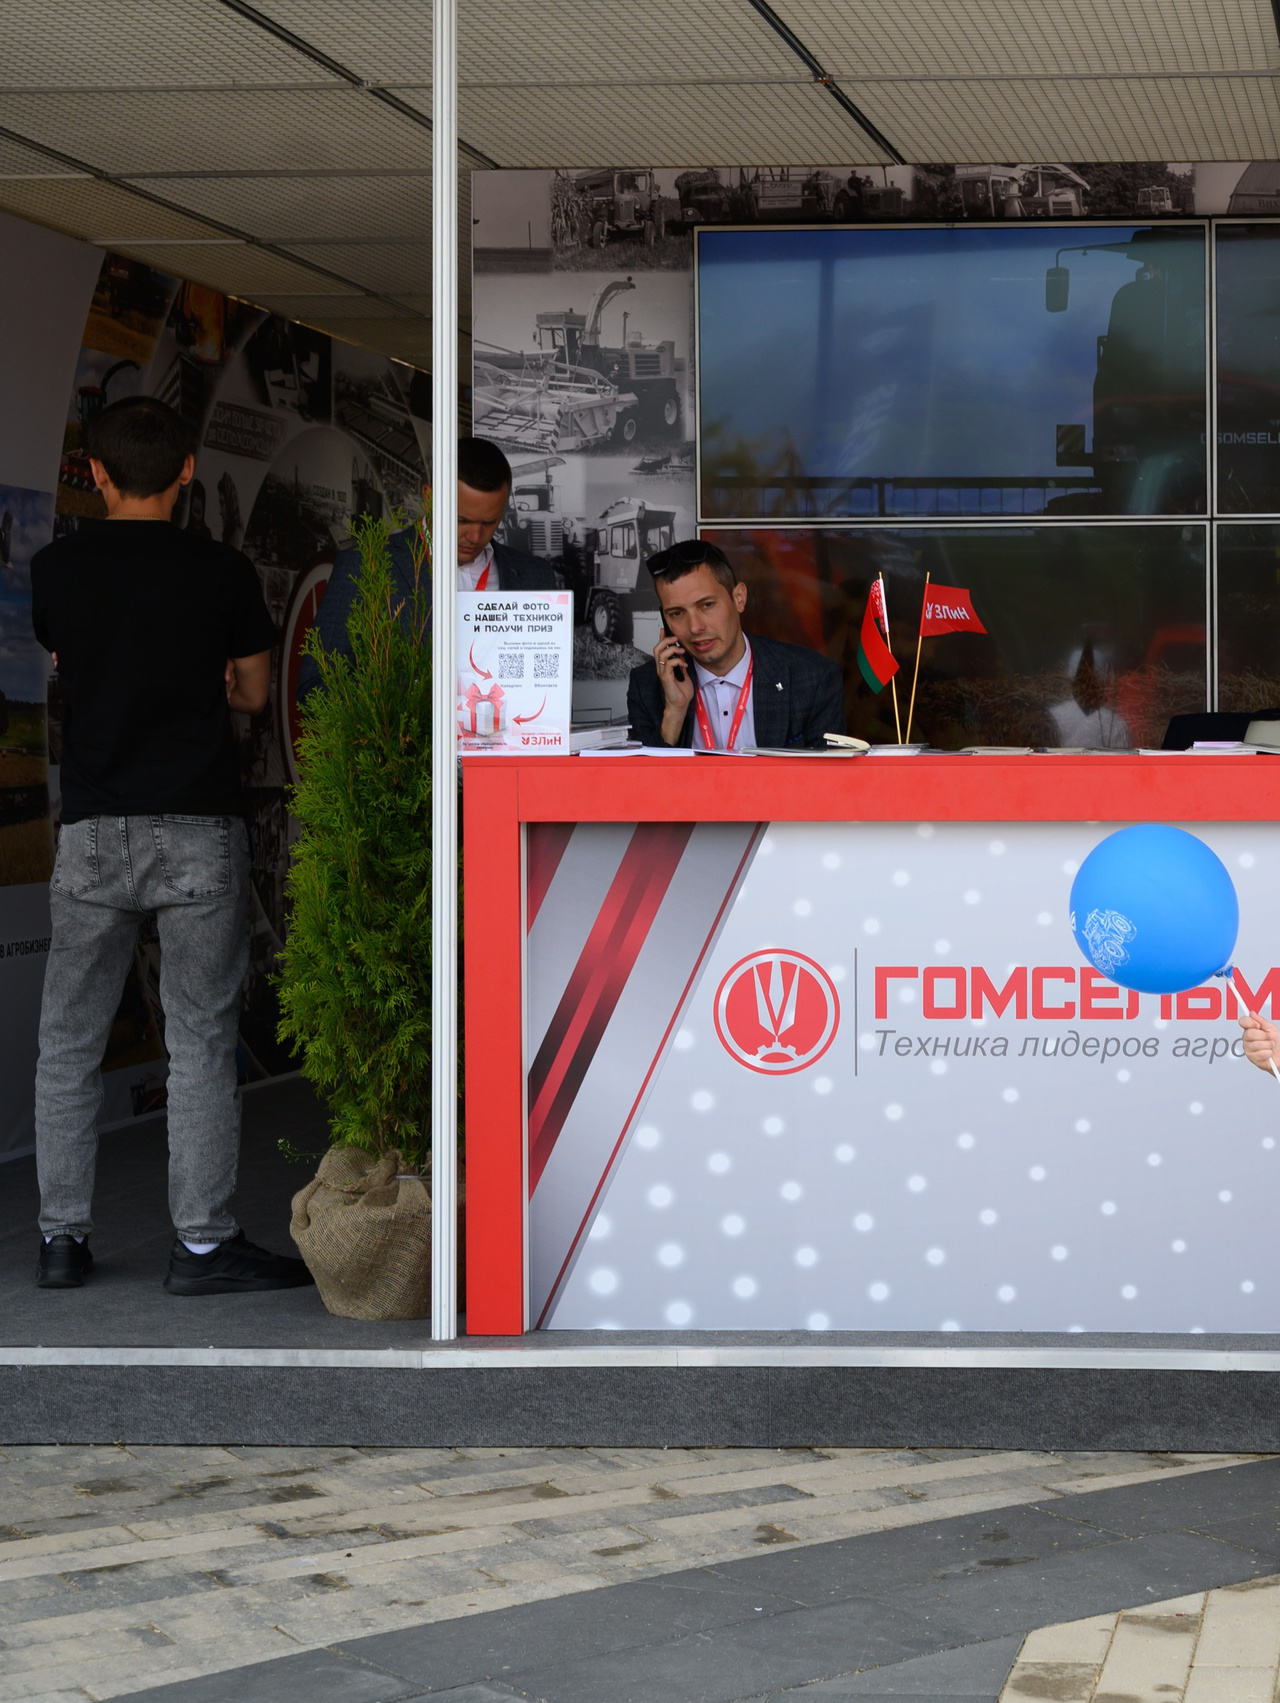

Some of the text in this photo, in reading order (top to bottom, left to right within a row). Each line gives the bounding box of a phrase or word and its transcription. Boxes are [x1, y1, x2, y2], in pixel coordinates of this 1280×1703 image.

[477, 602, 518, 611] СДЕЛАЙ
[463, 612, 563, 622] С НАШЕЙ ТЕХНИКОЙ
[875, 1029, 1009, 1057] Техника
[1018, 1030, 1160, 1064] лидеров
